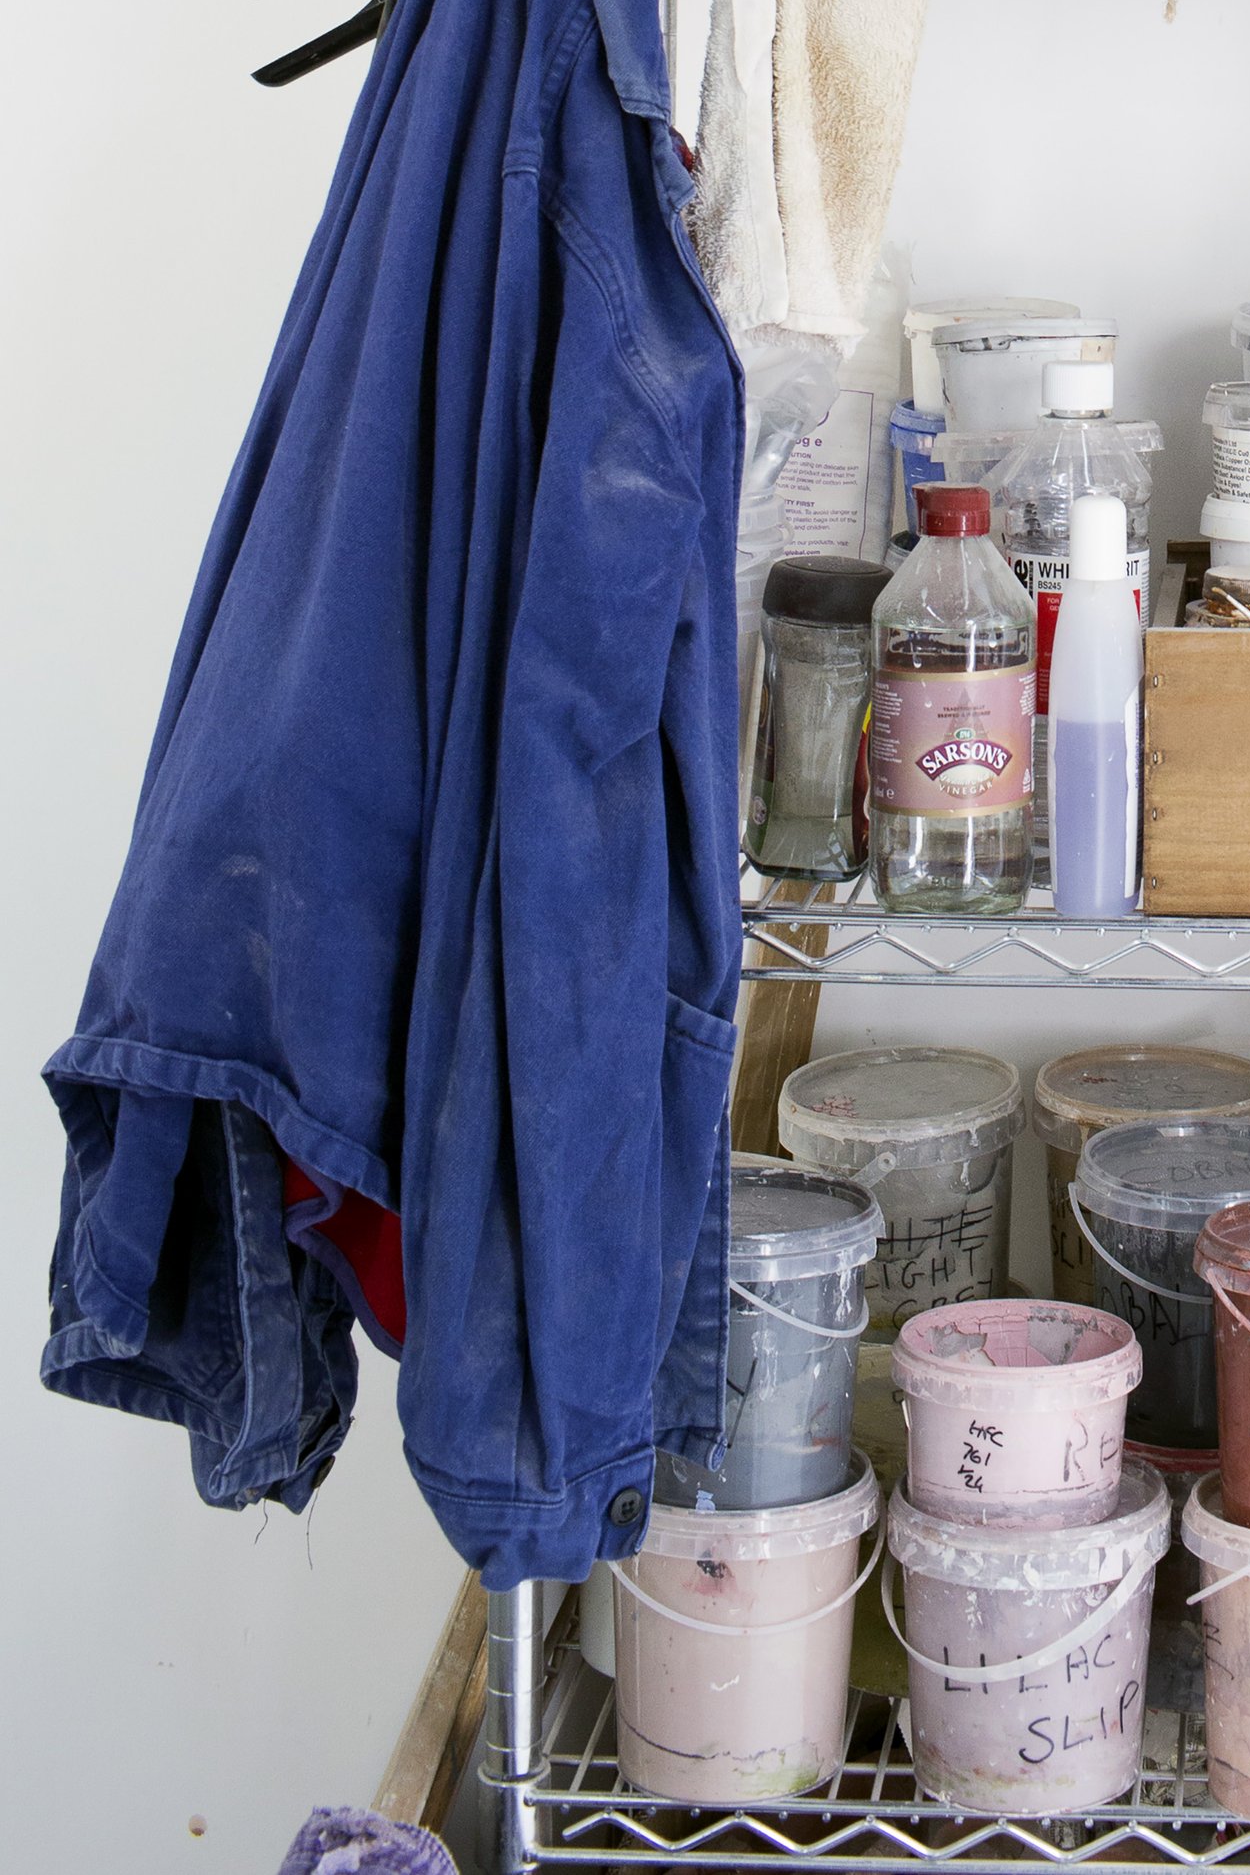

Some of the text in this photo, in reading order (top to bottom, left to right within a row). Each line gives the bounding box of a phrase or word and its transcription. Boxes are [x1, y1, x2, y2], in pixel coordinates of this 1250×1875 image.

[1037, 581, 1062, 590] BS245
[1038, 561, 1070, 579] WHI
[922, 741, 1008, 775] SARSON'S
[938, 781, 994, 796] VINEGAR
[865, 1242, 985, 1290] IGHT
[944, 1634, 1117, 1693] LILAC
[1019, 1680, 1139, 1765] SLIP
